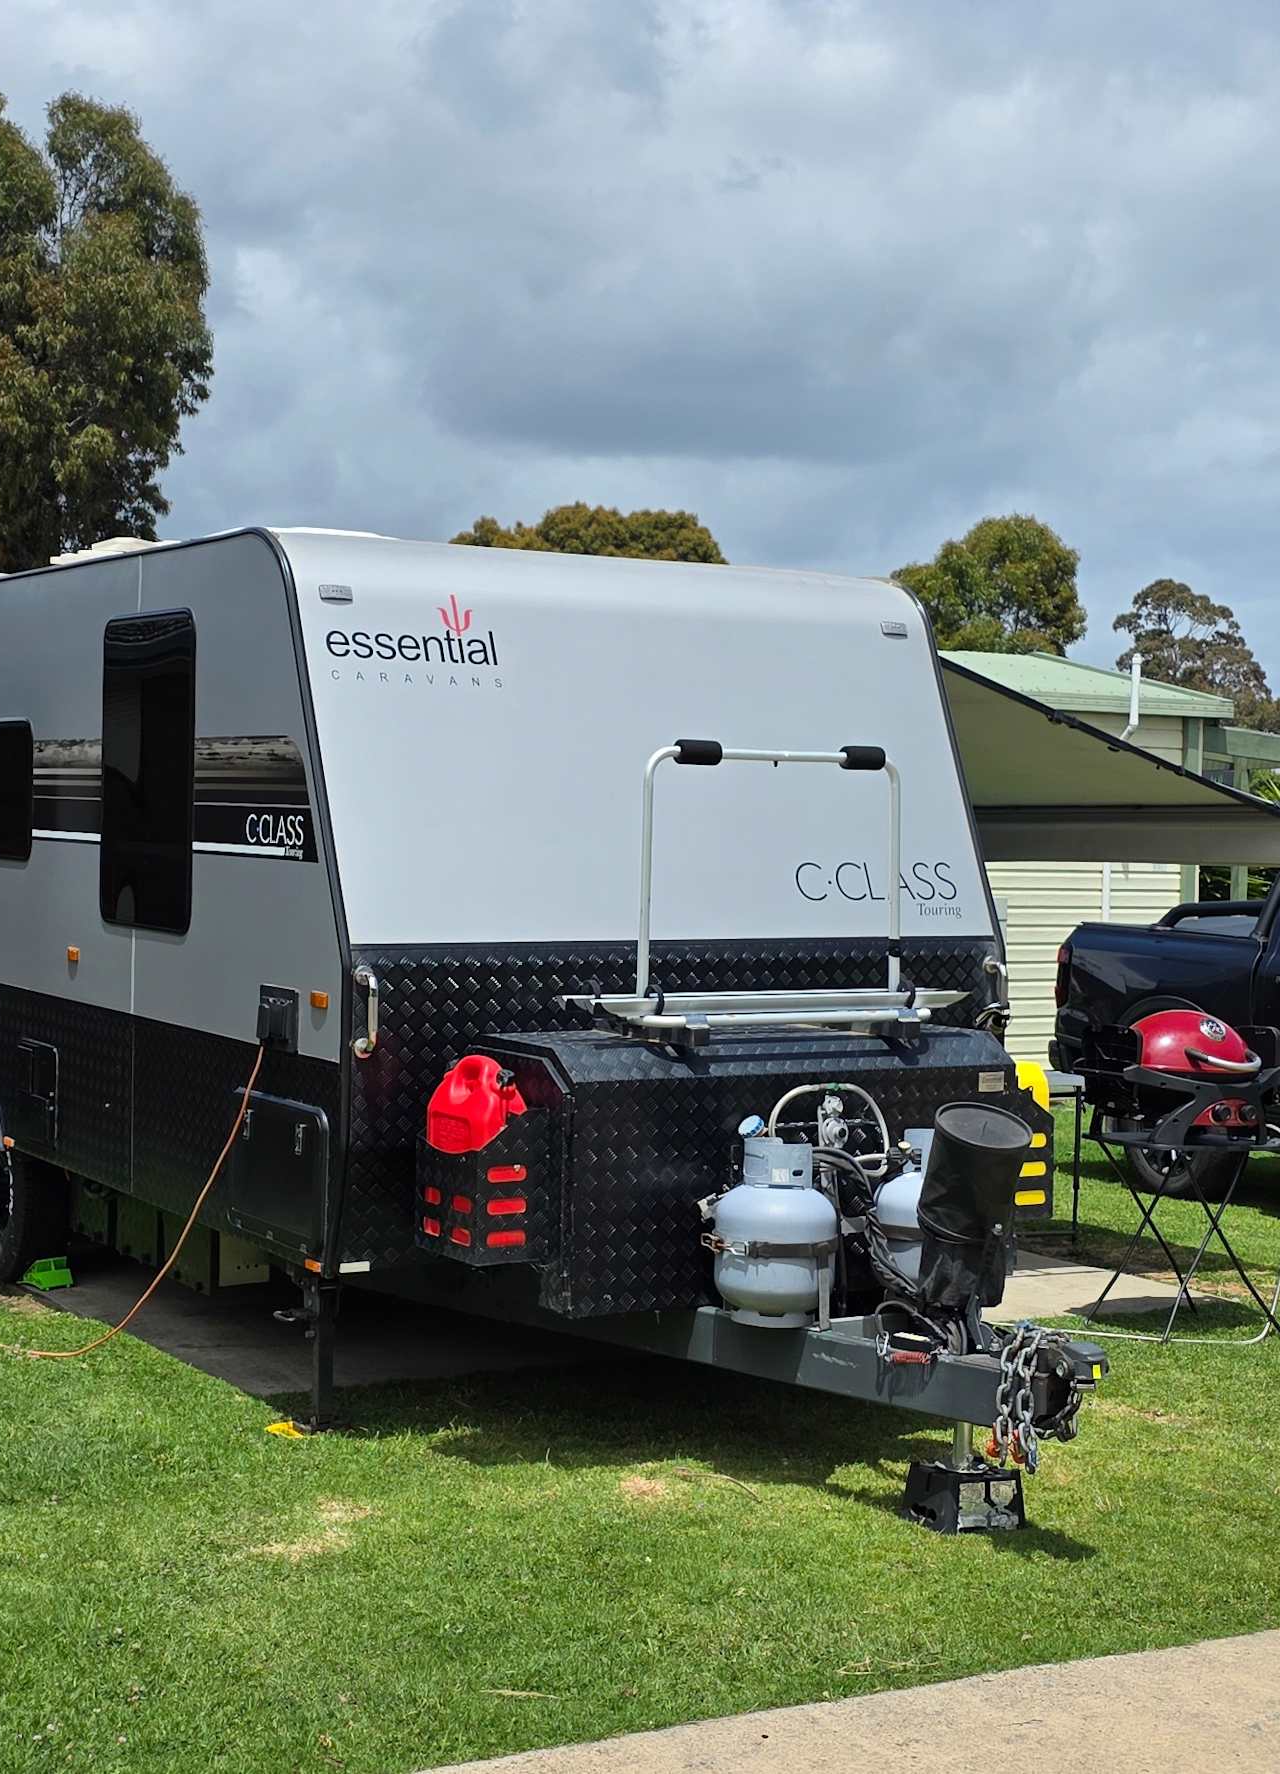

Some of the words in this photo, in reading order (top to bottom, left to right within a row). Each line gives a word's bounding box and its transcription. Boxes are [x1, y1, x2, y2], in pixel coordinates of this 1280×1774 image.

[325, 628, 499, 666] essential
[331, 669, 504, 689] CARAVANS
[916, 903, 962, 919] Touring
